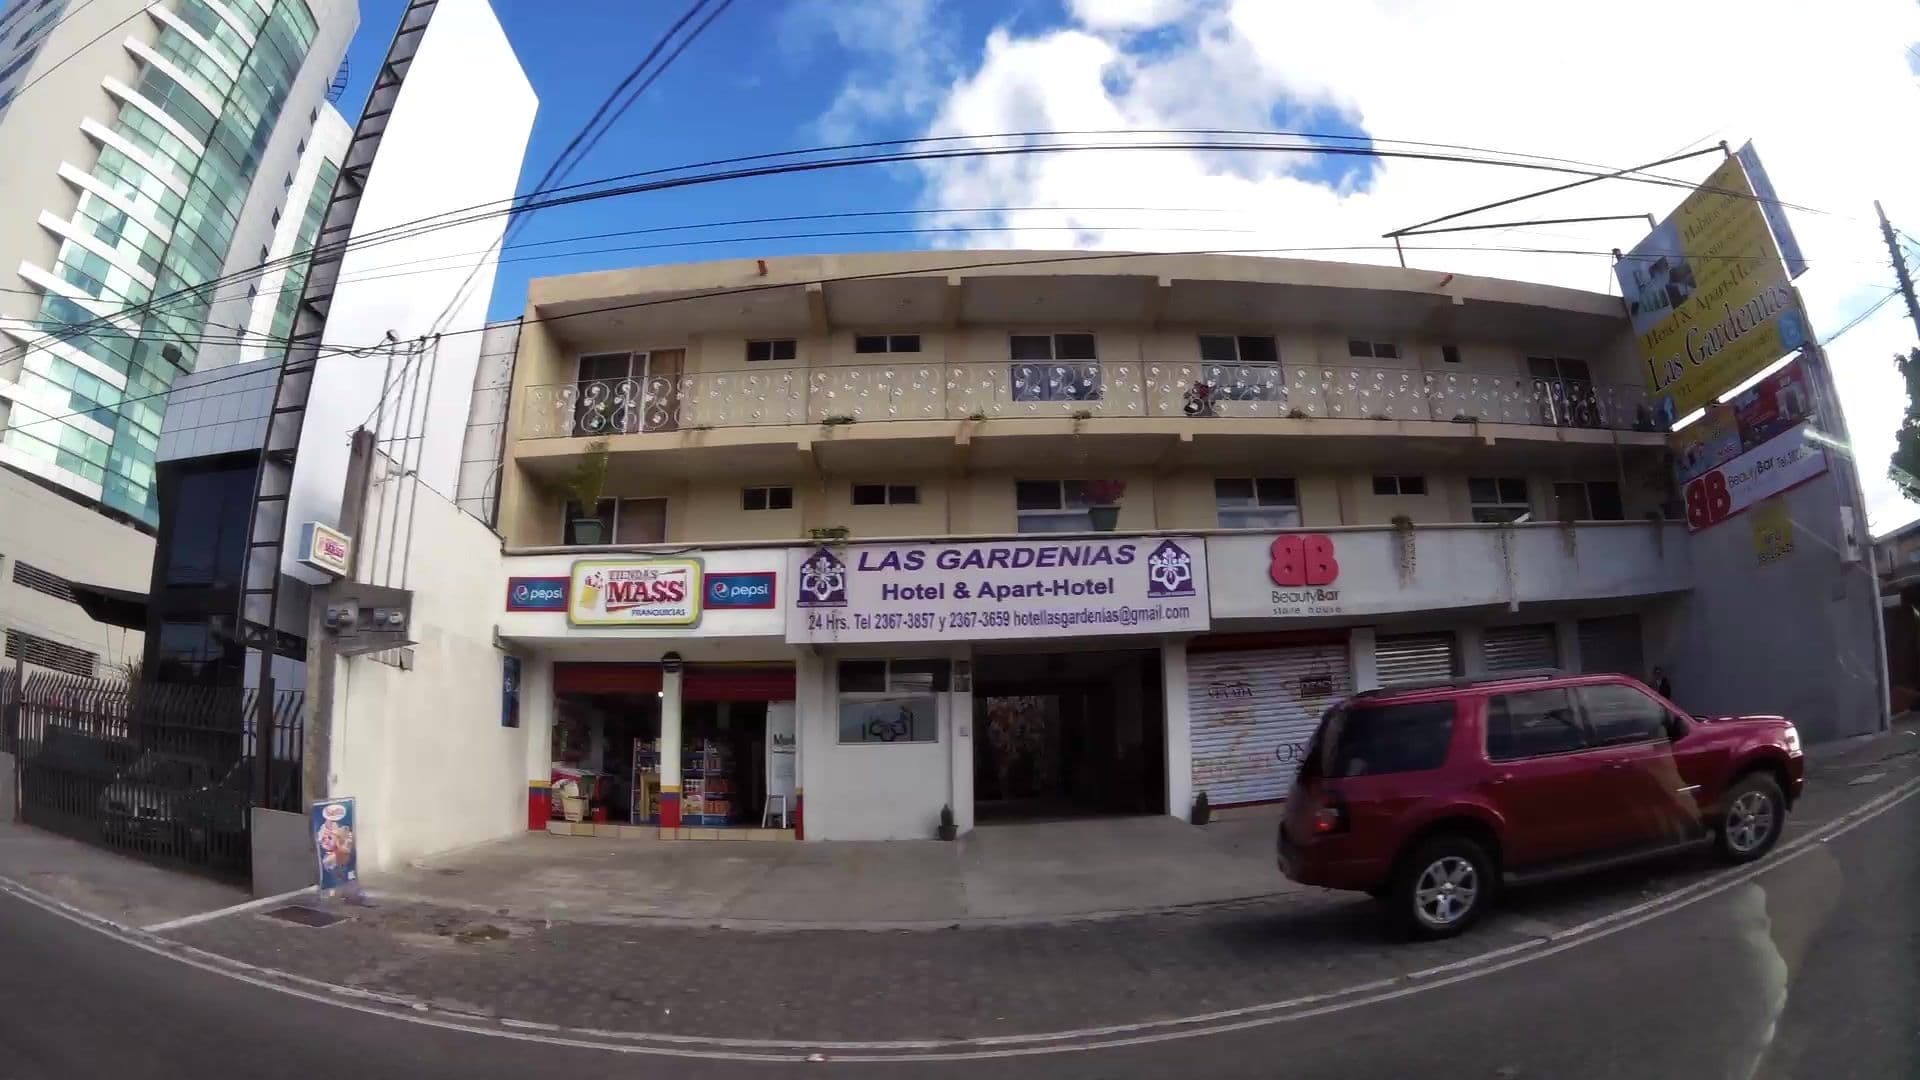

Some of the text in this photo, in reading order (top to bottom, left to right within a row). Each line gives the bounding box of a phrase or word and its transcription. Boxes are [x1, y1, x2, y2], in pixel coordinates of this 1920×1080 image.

[1648, 356, 1685, 392] Las
[1684, 284, 1794, 366] Gardenias
[857, 544, 1137, 572] LAS GARDENIAS
[530, 587, 563, 600] pepsi
[607, 581, 684, 602] MASS
[730, 584, 768, 598] pepsi
[882, 577, 1115, 602] Hotel & Apart-Hotel
[1271, 589, 1342, 604] BeautyBar
[808, 604, 1190, 632] 24 Hrs. Tel 2367-3857 y 2367-3659 hotellasgardenias@gmail.com
